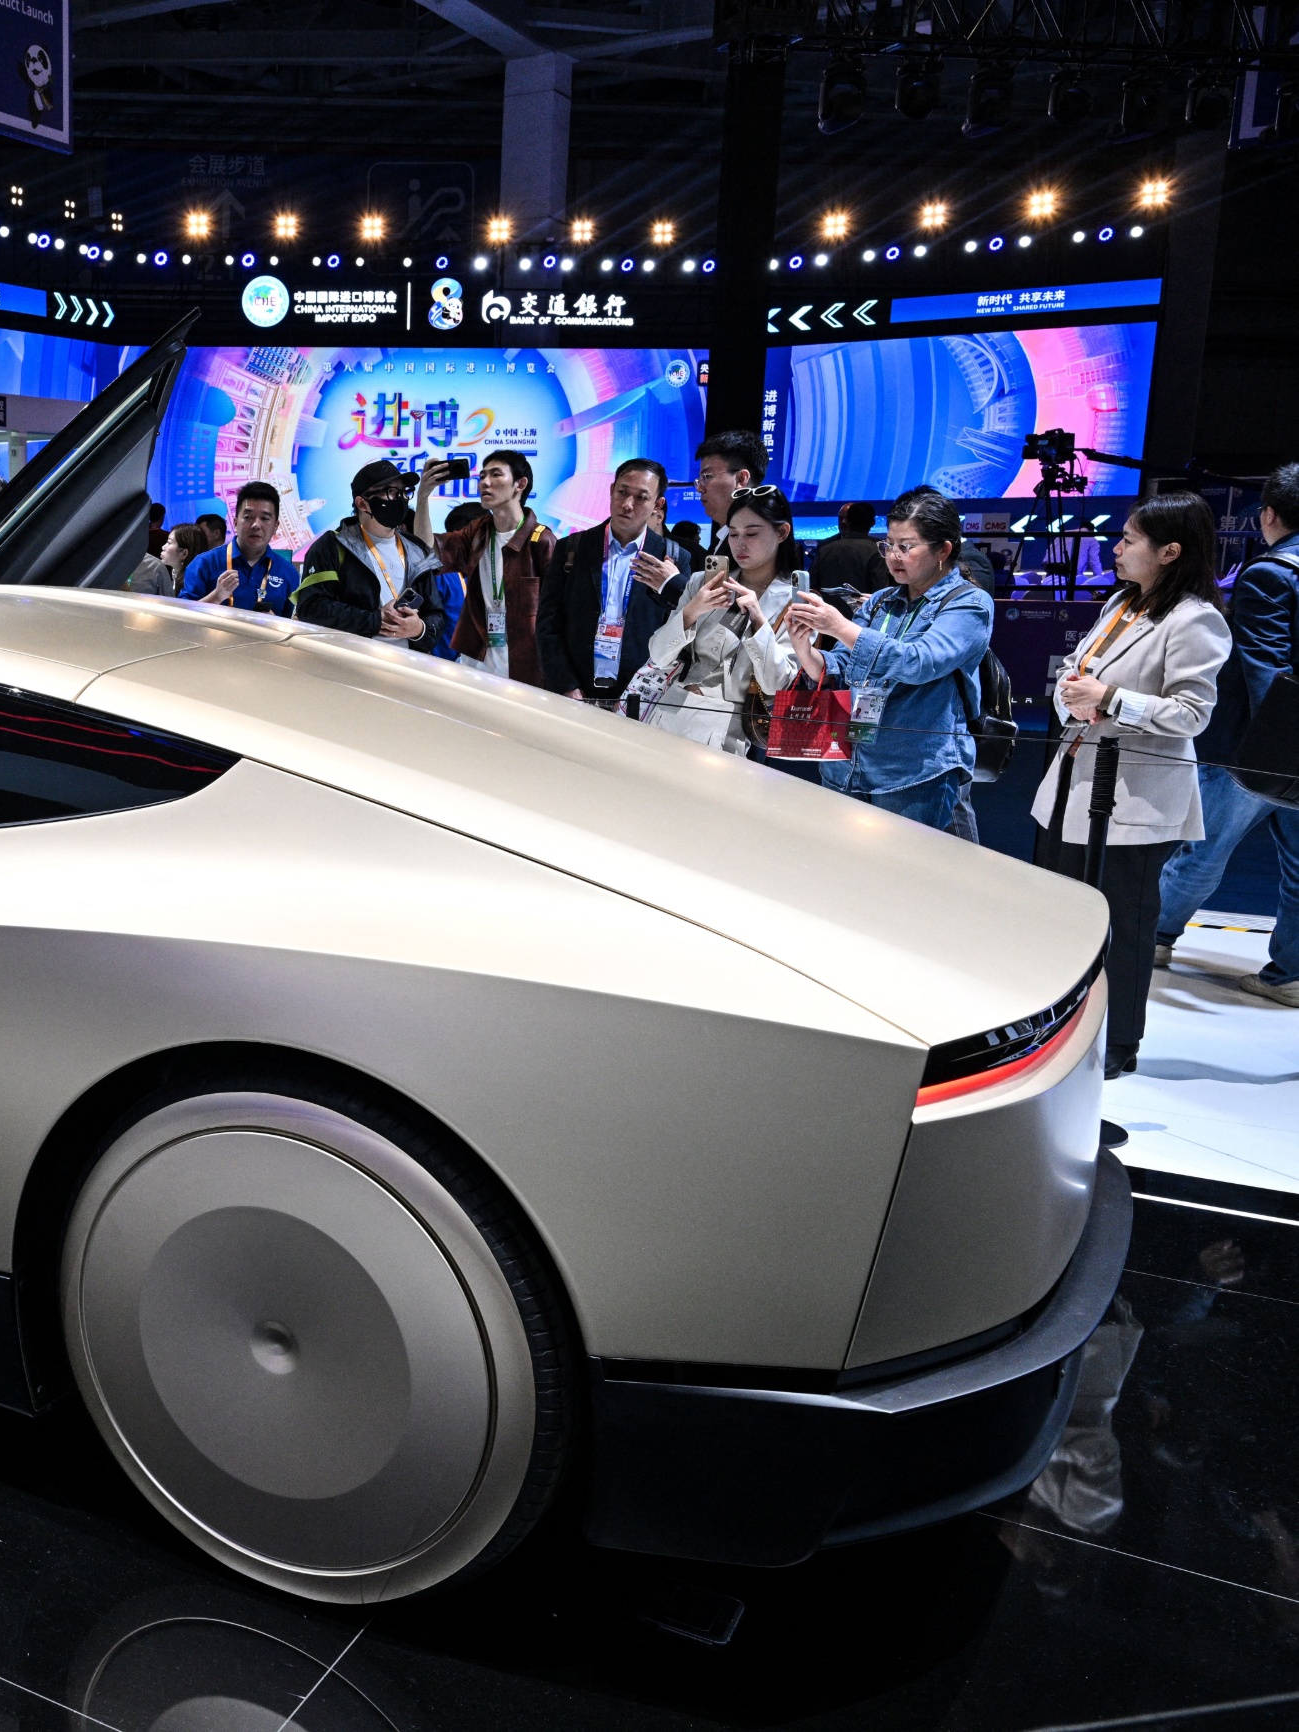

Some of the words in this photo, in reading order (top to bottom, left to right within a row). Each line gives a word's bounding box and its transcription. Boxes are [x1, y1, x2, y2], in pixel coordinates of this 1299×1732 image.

[22, 1, 53, 25] Launch
[189, 155, 266, 175] 会展步道
[181, 178, 233, 187] EXHIBITION
[235, 178, 272, 188] AVENUE
[293, 291, 397, 304] 中国国际进口博览会
[977, 294, 1012, 306] 新时代
[1019, 290, 1065, 303] 共享未来
[294, 305, 323, 314] CHINA
[325, 304, 397, 314] INTERNATIONAL
[315, 314, 349, 323] IMPORT
[351, 314, 377, 323] EXPO
[509, 316, 534, 325] BANK
[538, 316, 551, 325] OF
[554, 317, 634, 326] COMMUNICATIONS
[322, 362, 556, 374] 第八届中国国际进口博览会
[762, 390, 778, 460] 进博新品
[966, 522, 979, 530] CMG
[985, 522, 1006, 530] CMG
[1219, 515, 1257, 531] 第八
[1219, 537, 1239, 545] THE
